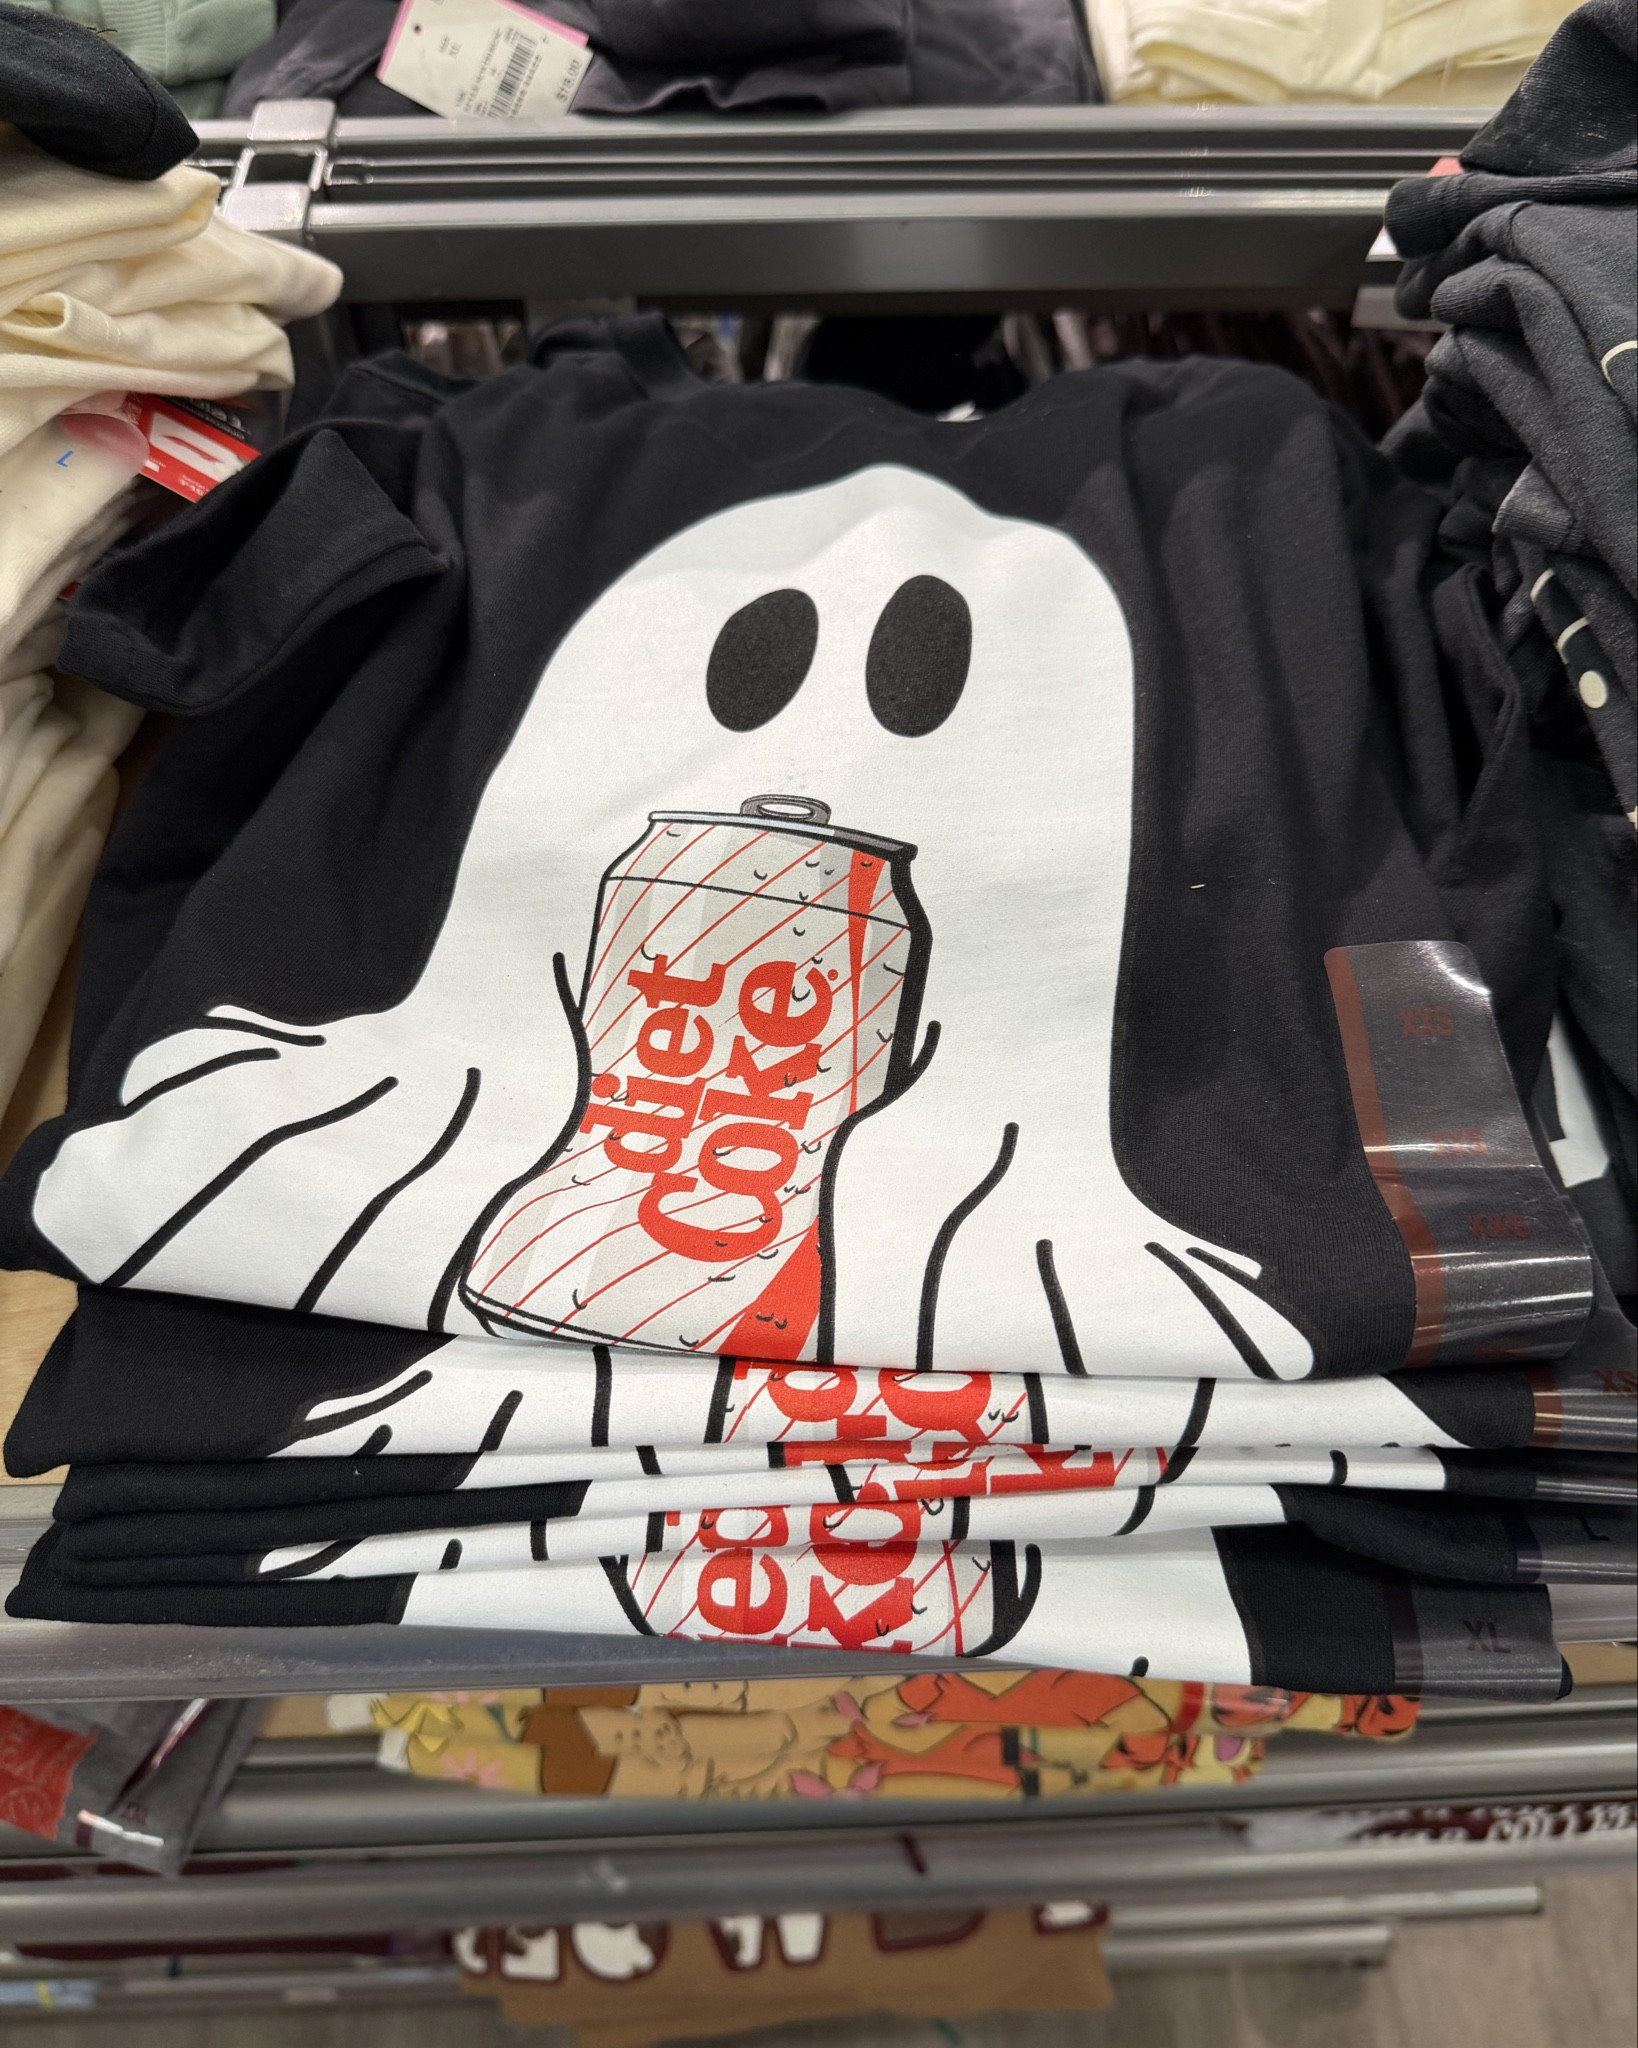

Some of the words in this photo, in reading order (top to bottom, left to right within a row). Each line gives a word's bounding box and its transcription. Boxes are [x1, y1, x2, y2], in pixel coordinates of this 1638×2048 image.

[1397, 1007, 1456, 1039] XXS
[579, 954, 726, 1173] diet
[1425, 1127, 1487, 1158] XXS
[1465, 1213, 1532, 1239] XXS
[1463, 1618, 1512, 1653] XL
